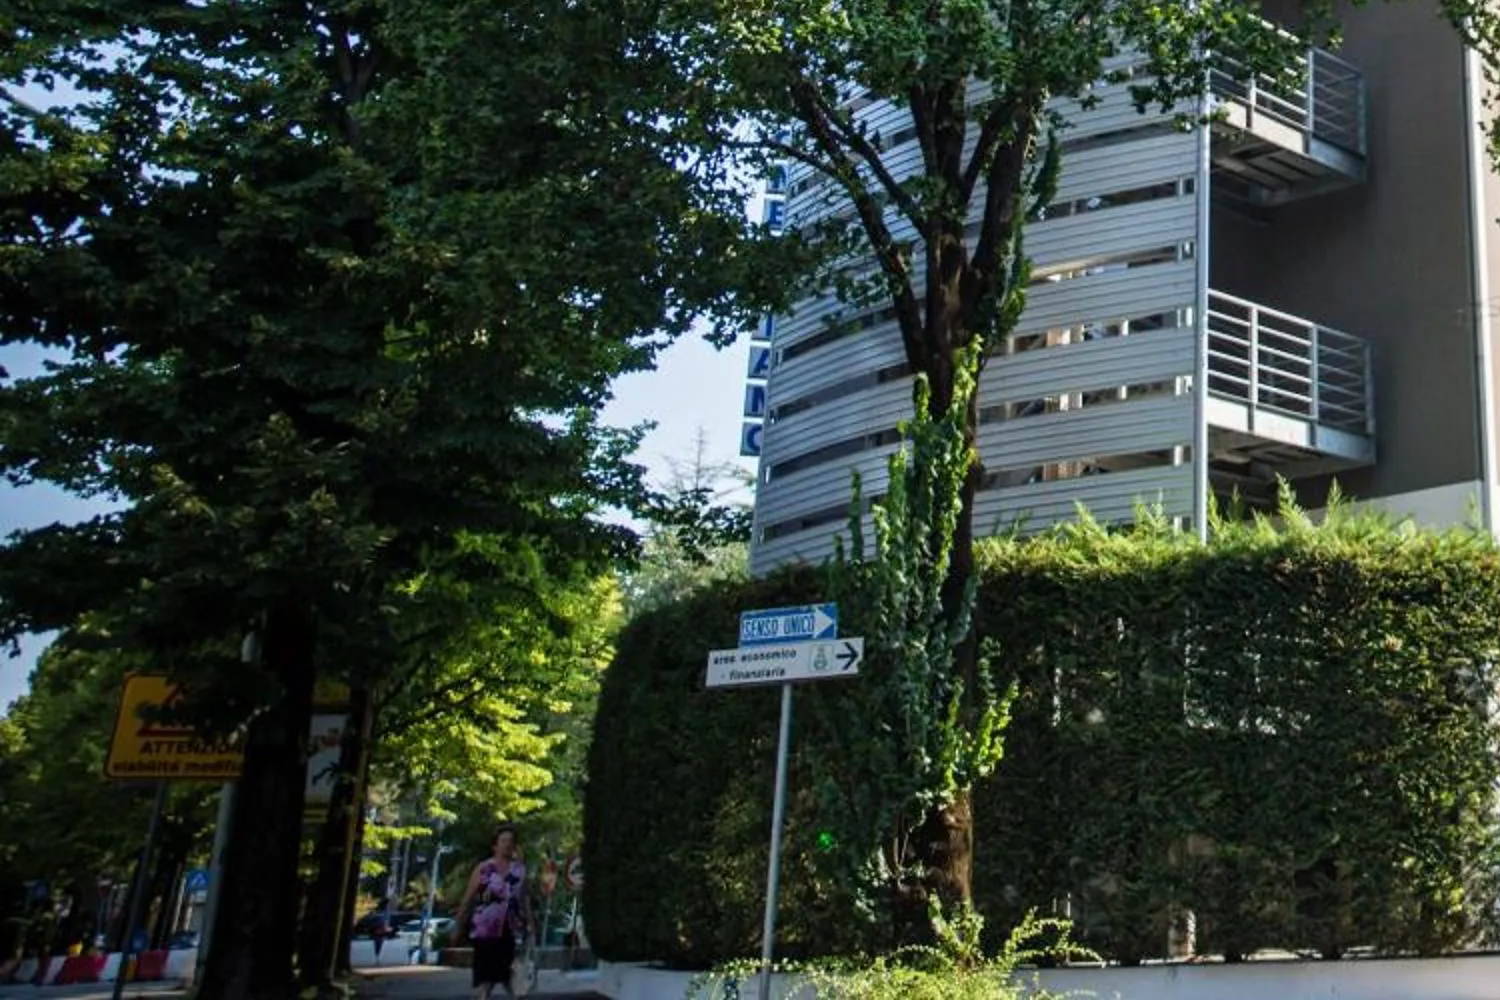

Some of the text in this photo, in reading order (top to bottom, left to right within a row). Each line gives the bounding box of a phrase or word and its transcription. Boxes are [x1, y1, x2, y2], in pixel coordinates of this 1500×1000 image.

[743, 614, 815, 638] SENSO UNICO
[713, 655, 736, 665] area
[729, 667, 785, 680] finanziaria
